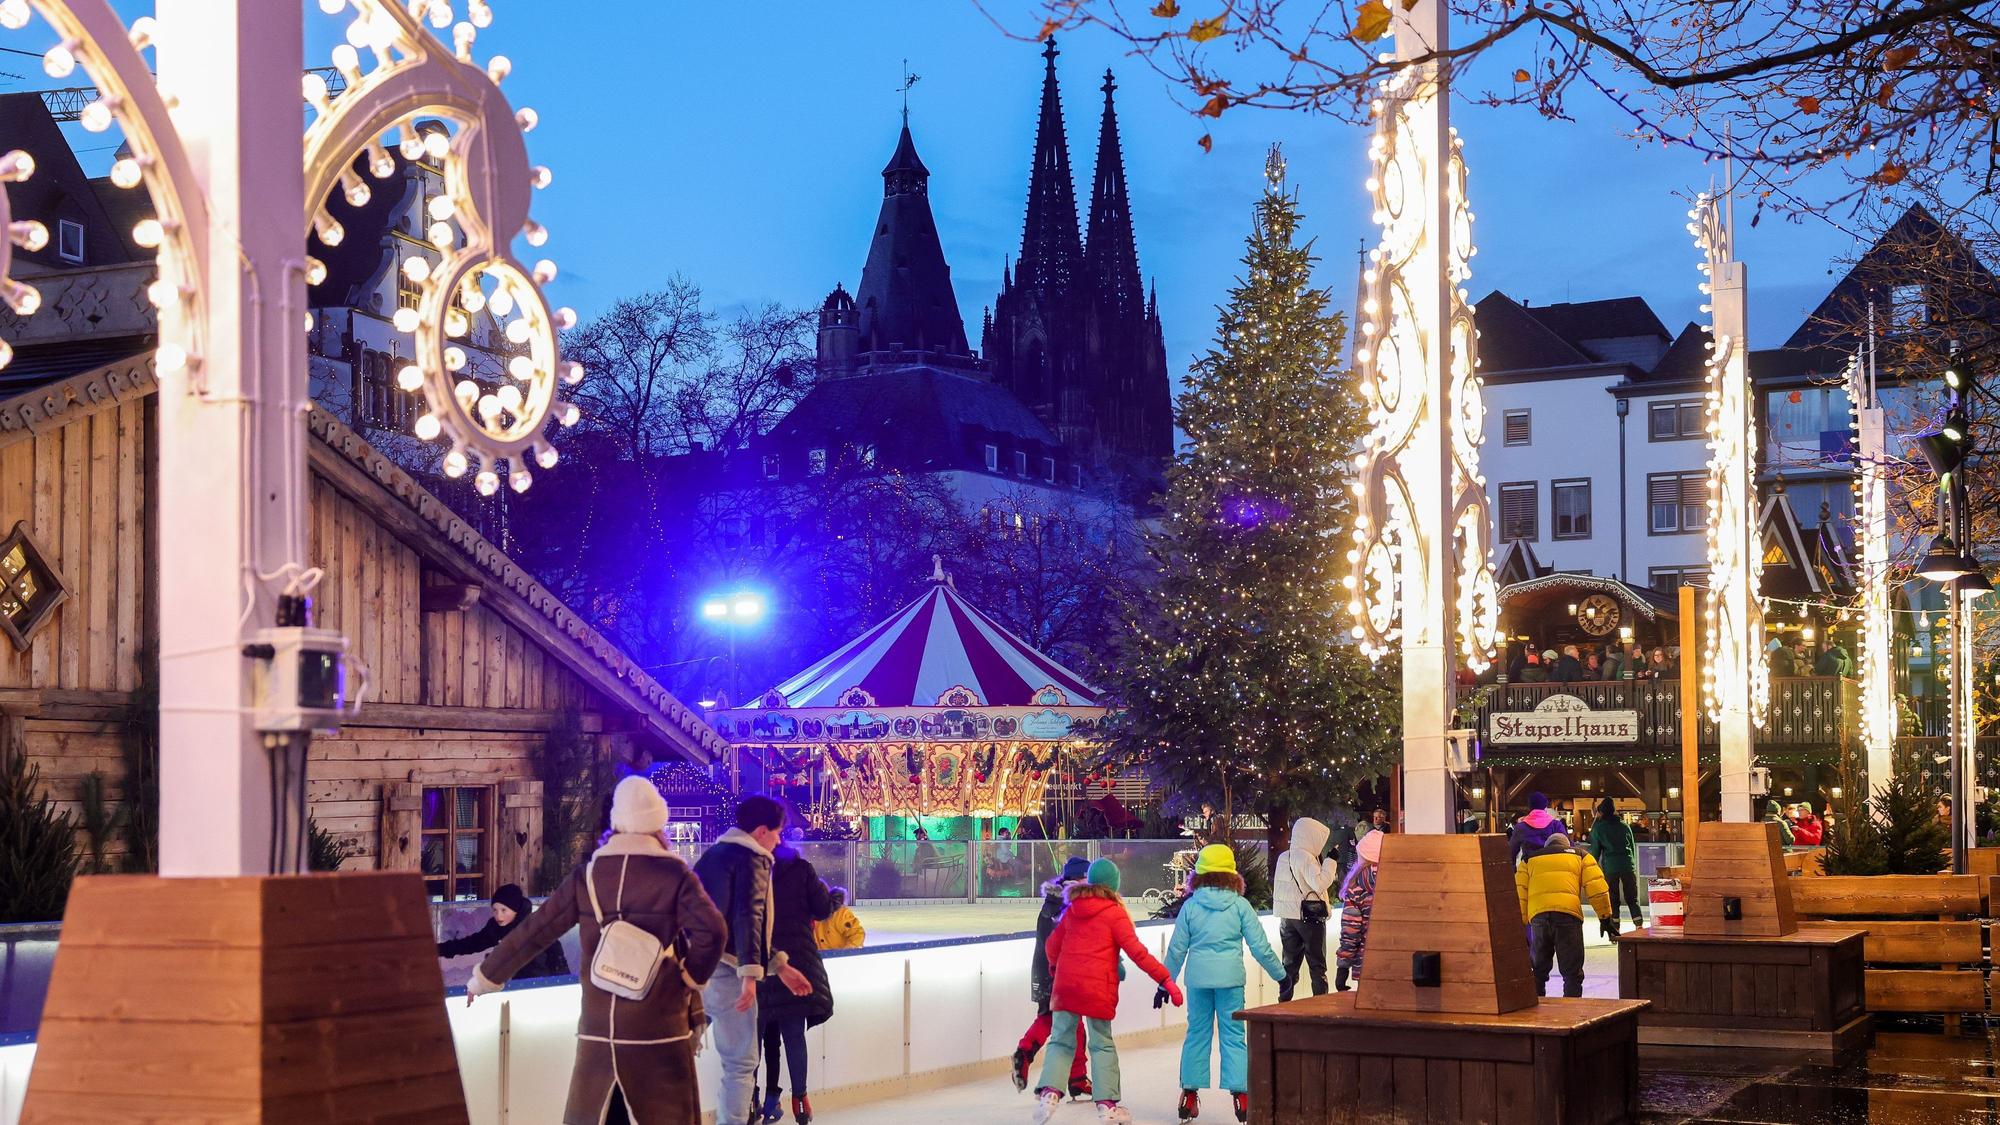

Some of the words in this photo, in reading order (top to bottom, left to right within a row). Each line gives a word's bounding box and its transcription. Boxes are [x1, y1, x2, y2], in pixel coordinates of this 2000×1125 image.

[1494, 715, 1630, 742] Stapelhaus
[1046, 782, 1082, 791] eumarkt
[601, 964, 639, 983] CONVERSE
